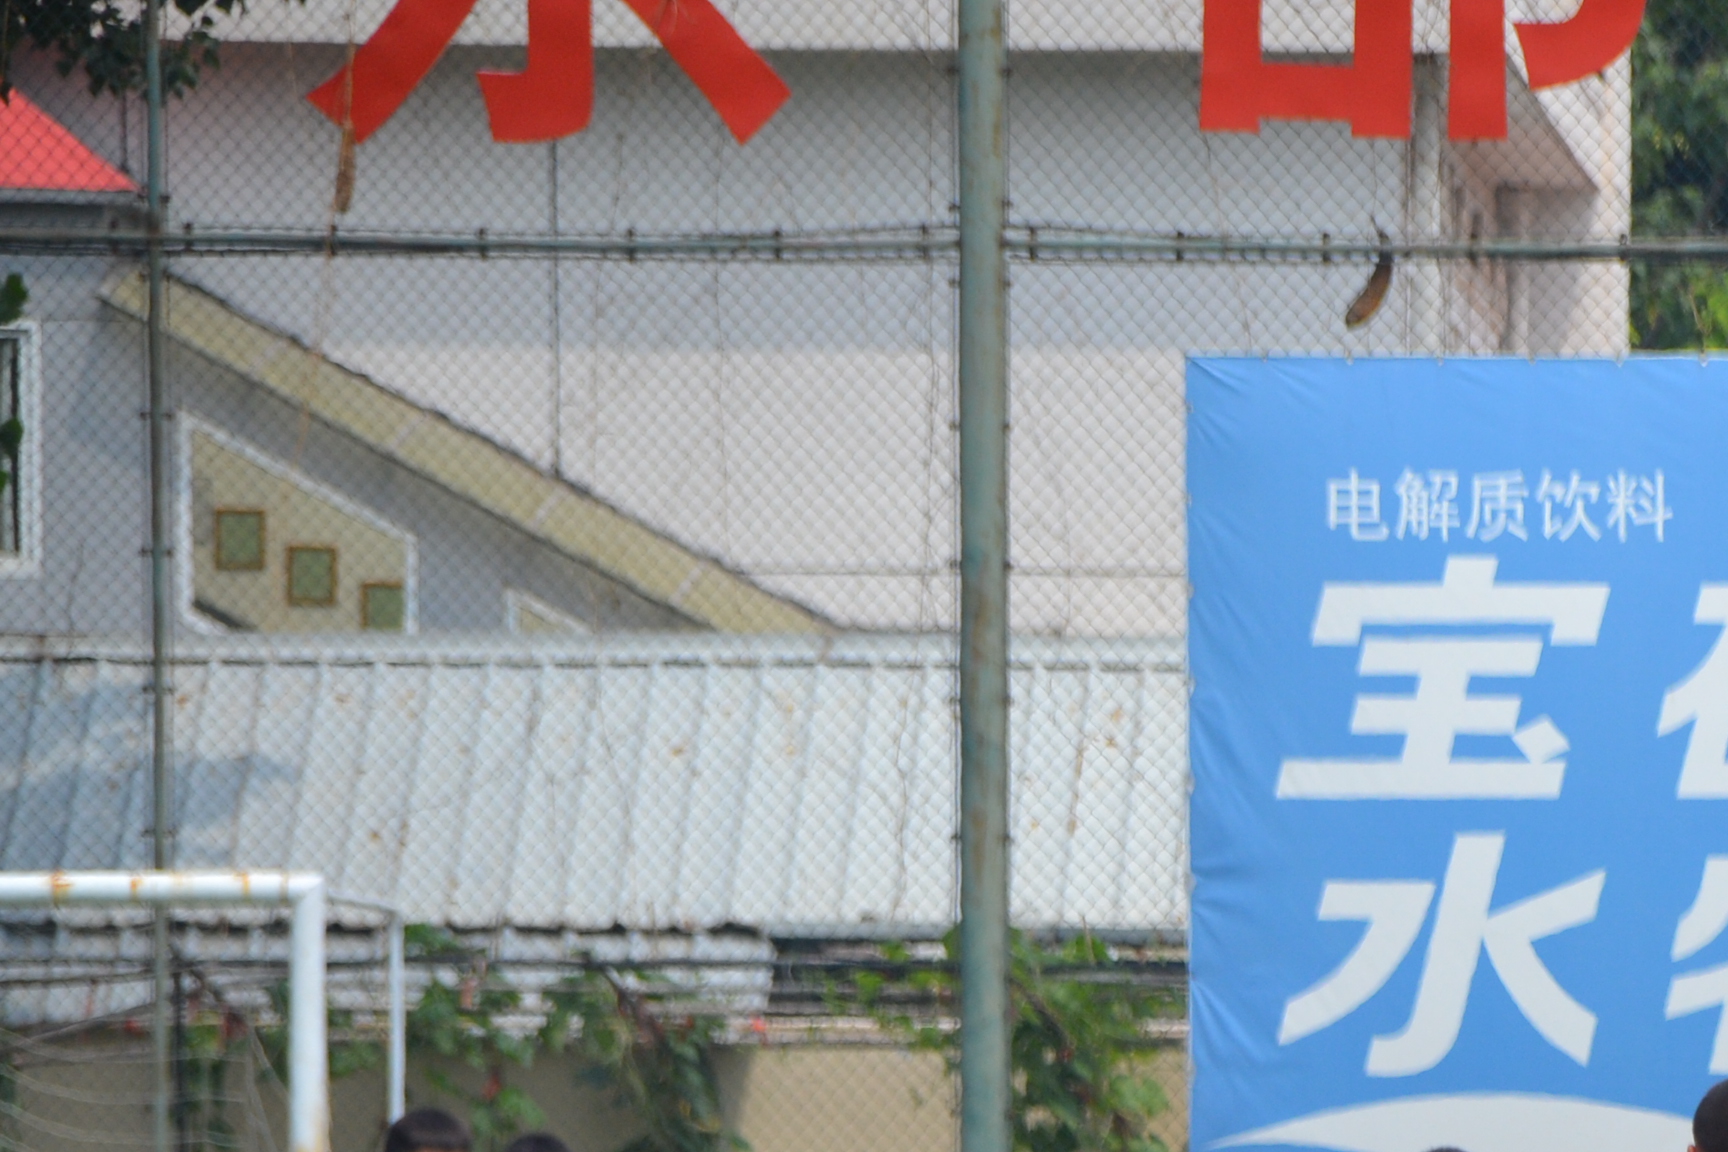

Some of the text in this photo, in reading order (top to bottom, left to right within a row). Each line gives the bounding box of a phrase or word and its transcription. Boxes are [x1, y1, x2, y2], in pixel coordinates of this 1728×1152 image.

[1325, 469, 1674, 542] 电解质饮料
